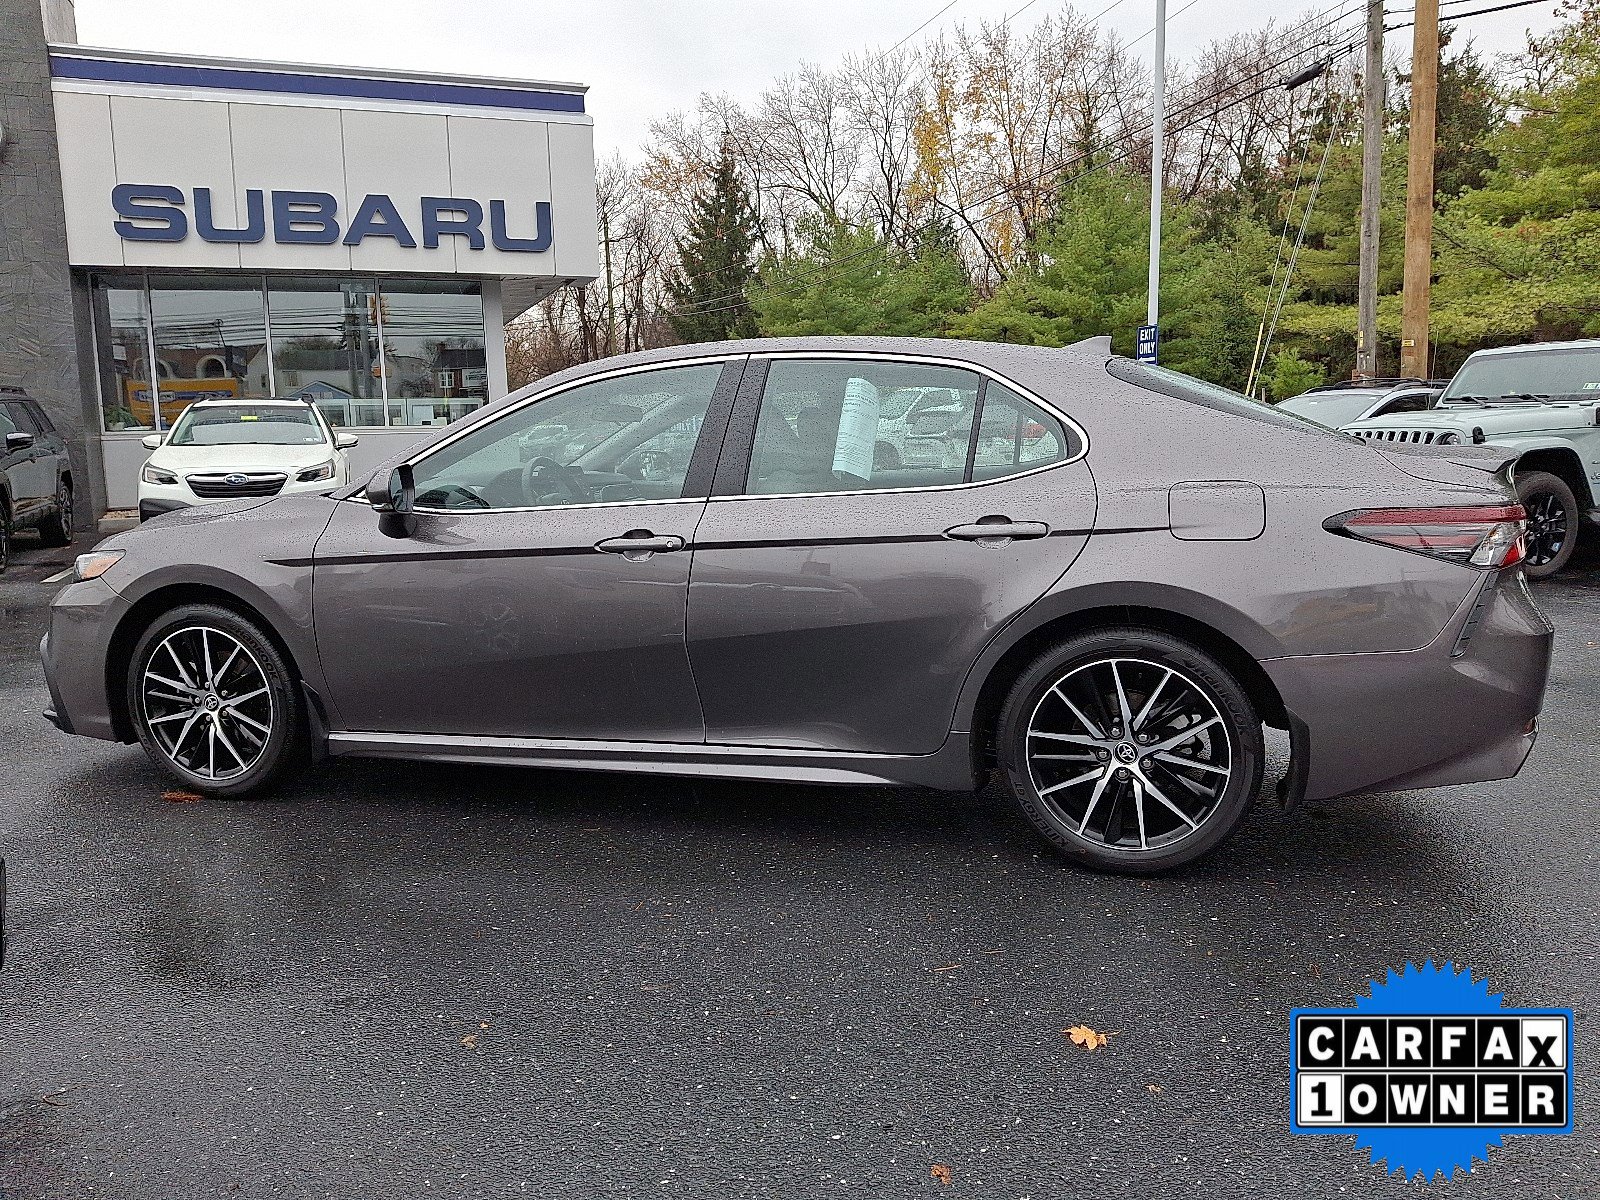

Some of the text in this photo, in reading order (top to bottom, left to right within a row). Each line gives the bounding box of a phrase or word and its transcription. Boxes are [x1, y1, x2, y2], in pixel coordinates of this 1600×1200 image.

[112, 183, 552, 252] SUBARU
[1140, 328, 1156, 341] EXIT
[1139, 342, 1156, 355] ONLY
